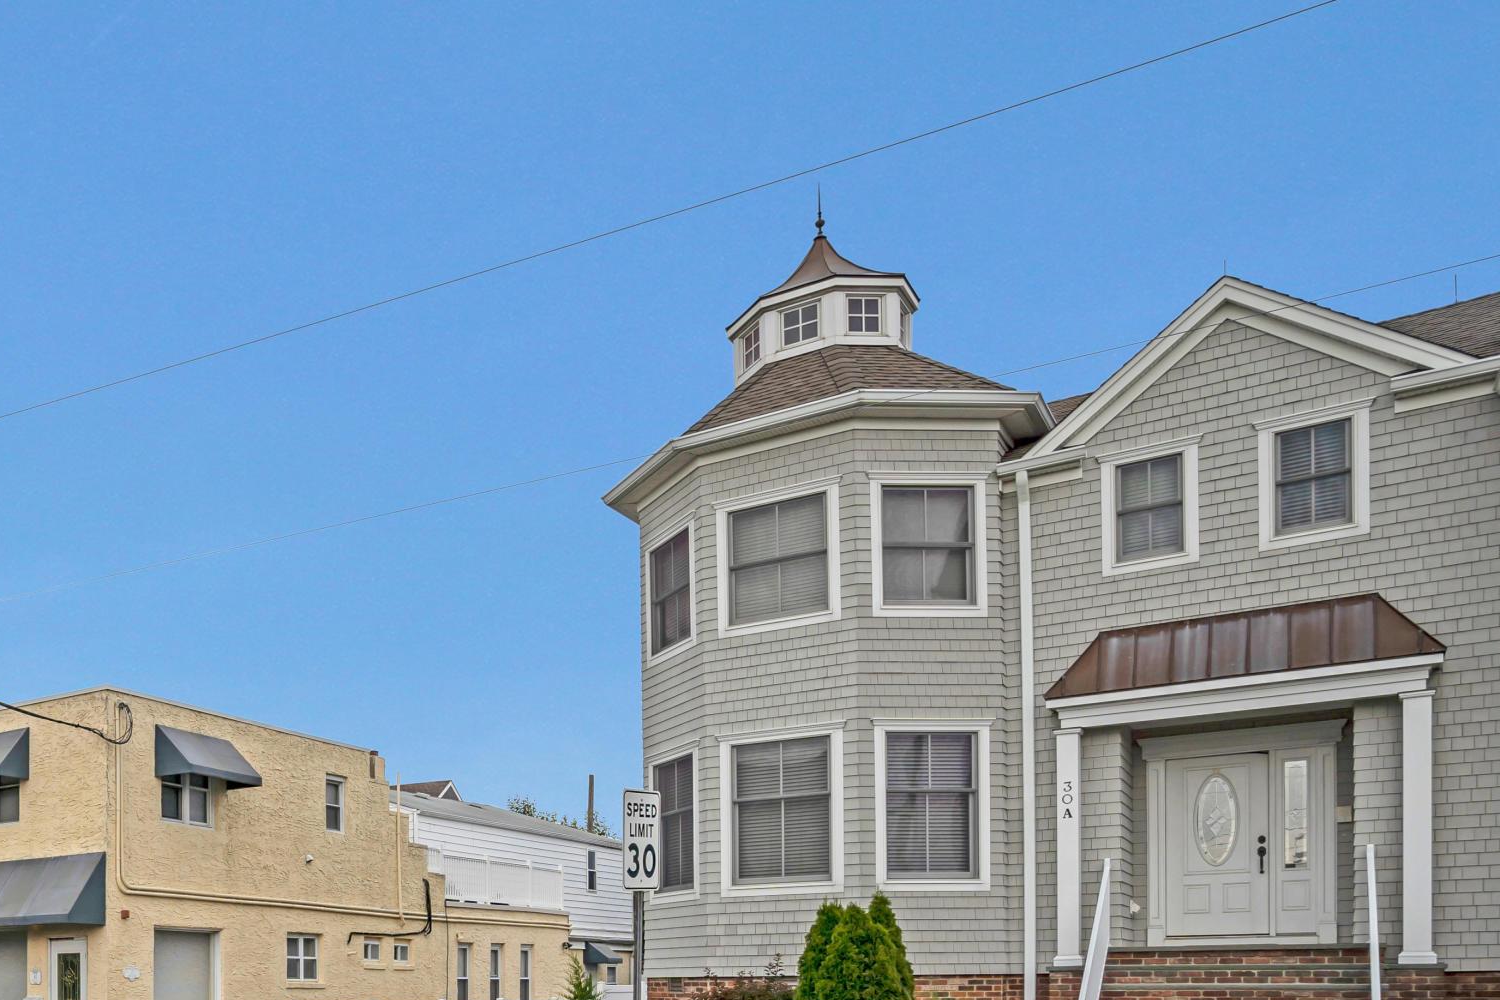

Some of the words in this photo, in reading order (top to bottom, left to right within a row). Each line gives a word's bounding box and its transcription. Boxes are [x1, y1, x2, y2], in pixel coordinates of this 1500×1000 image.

[626, 802, 658, 819] SPEED
[629, 822, 655, 838] LIMIT
[626, 842, 656, 879] 30
